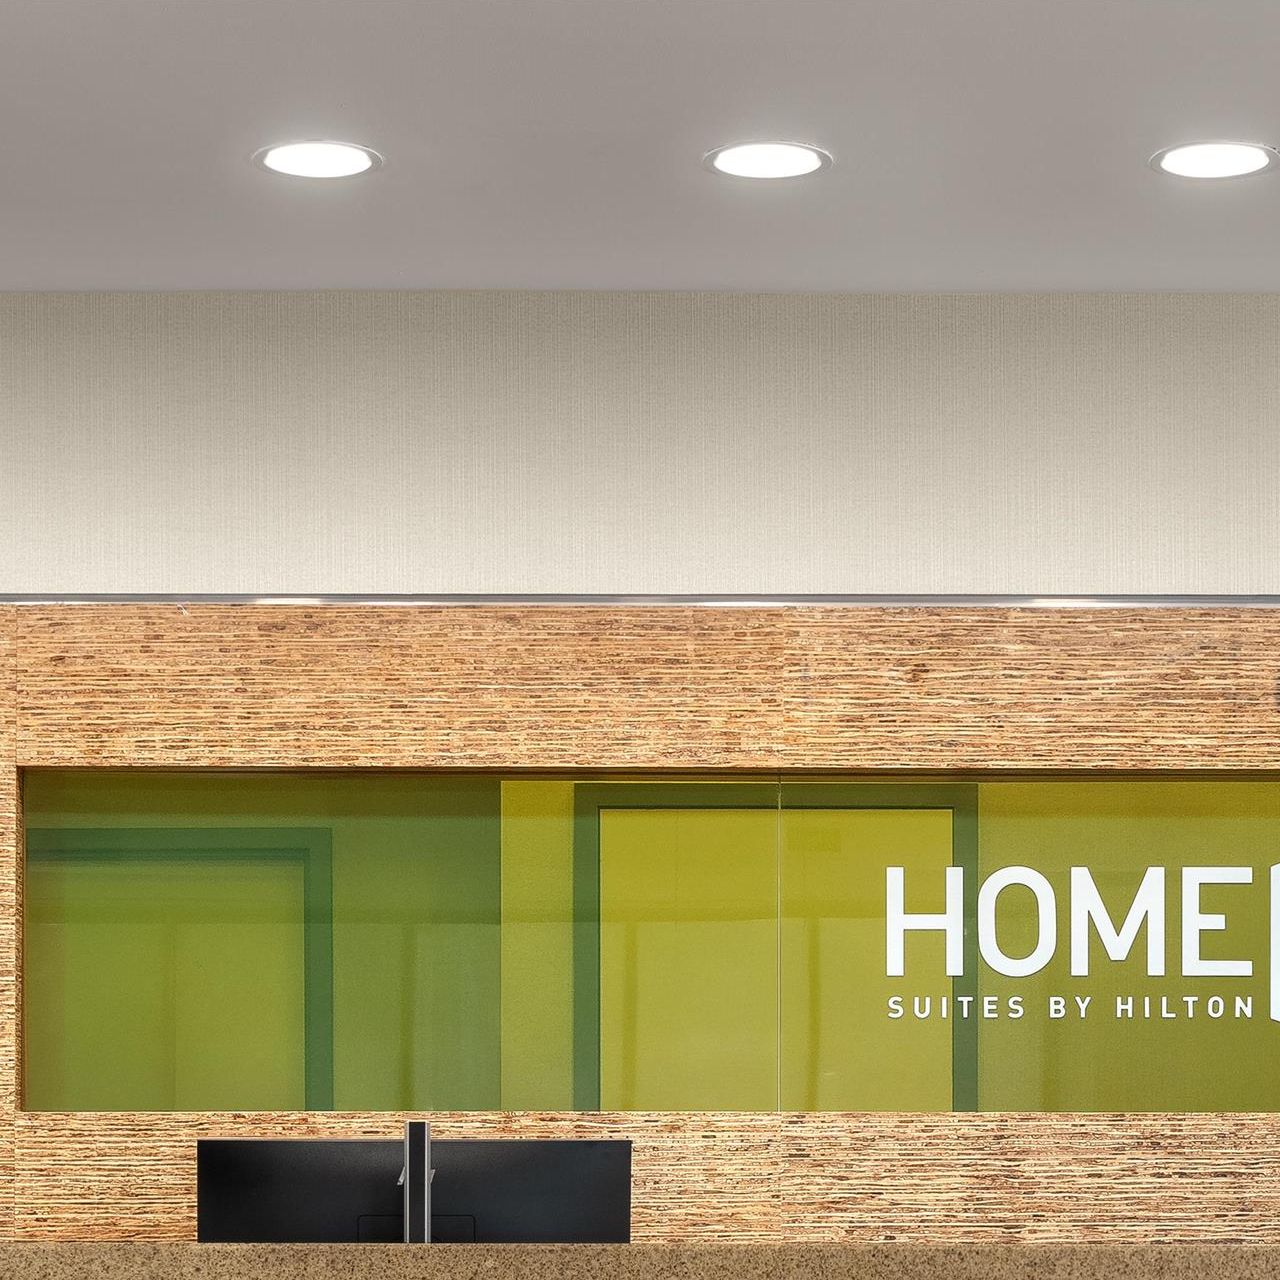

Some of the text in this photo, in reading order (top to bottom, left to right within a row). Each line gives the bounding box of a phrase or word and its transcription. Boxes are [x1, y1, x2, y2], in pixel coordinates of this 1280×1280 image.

[885, 865, 1254, 977] HOME
[887, 995, 1253, 1019] SUITES BY HILTON
